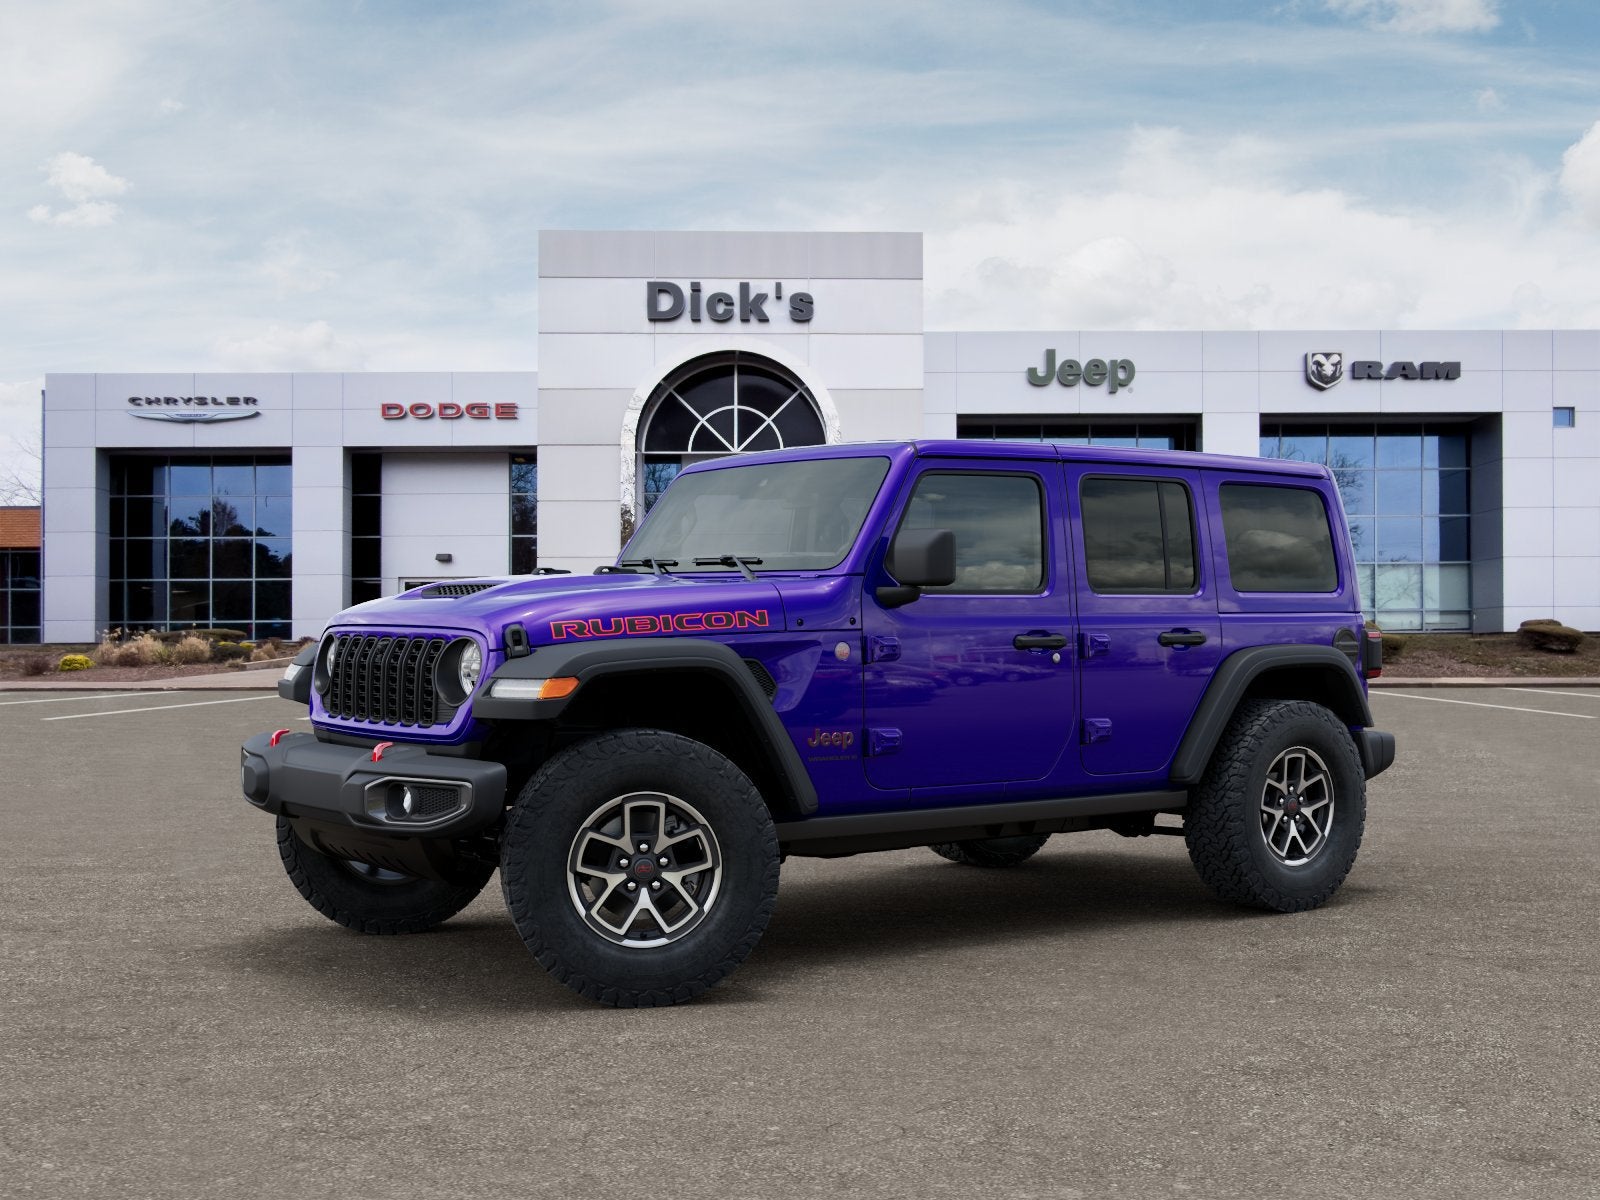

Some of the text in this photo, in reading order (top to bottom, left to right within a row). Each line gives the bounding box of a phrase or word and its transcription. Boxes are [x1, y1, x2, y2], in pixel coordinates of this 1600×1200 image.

[647, 281, 814, 322] Dick's
[1027, 349, 1135, 394] Jeep
[1352, 361, 1461, 380] RAM
[128, 396, 258, 407] CHRYSLER
[381, 403, 518, 420] DODGE
[550, 609, 769, 640] RUBICON
[808, 728, 854, 749] Jeep
